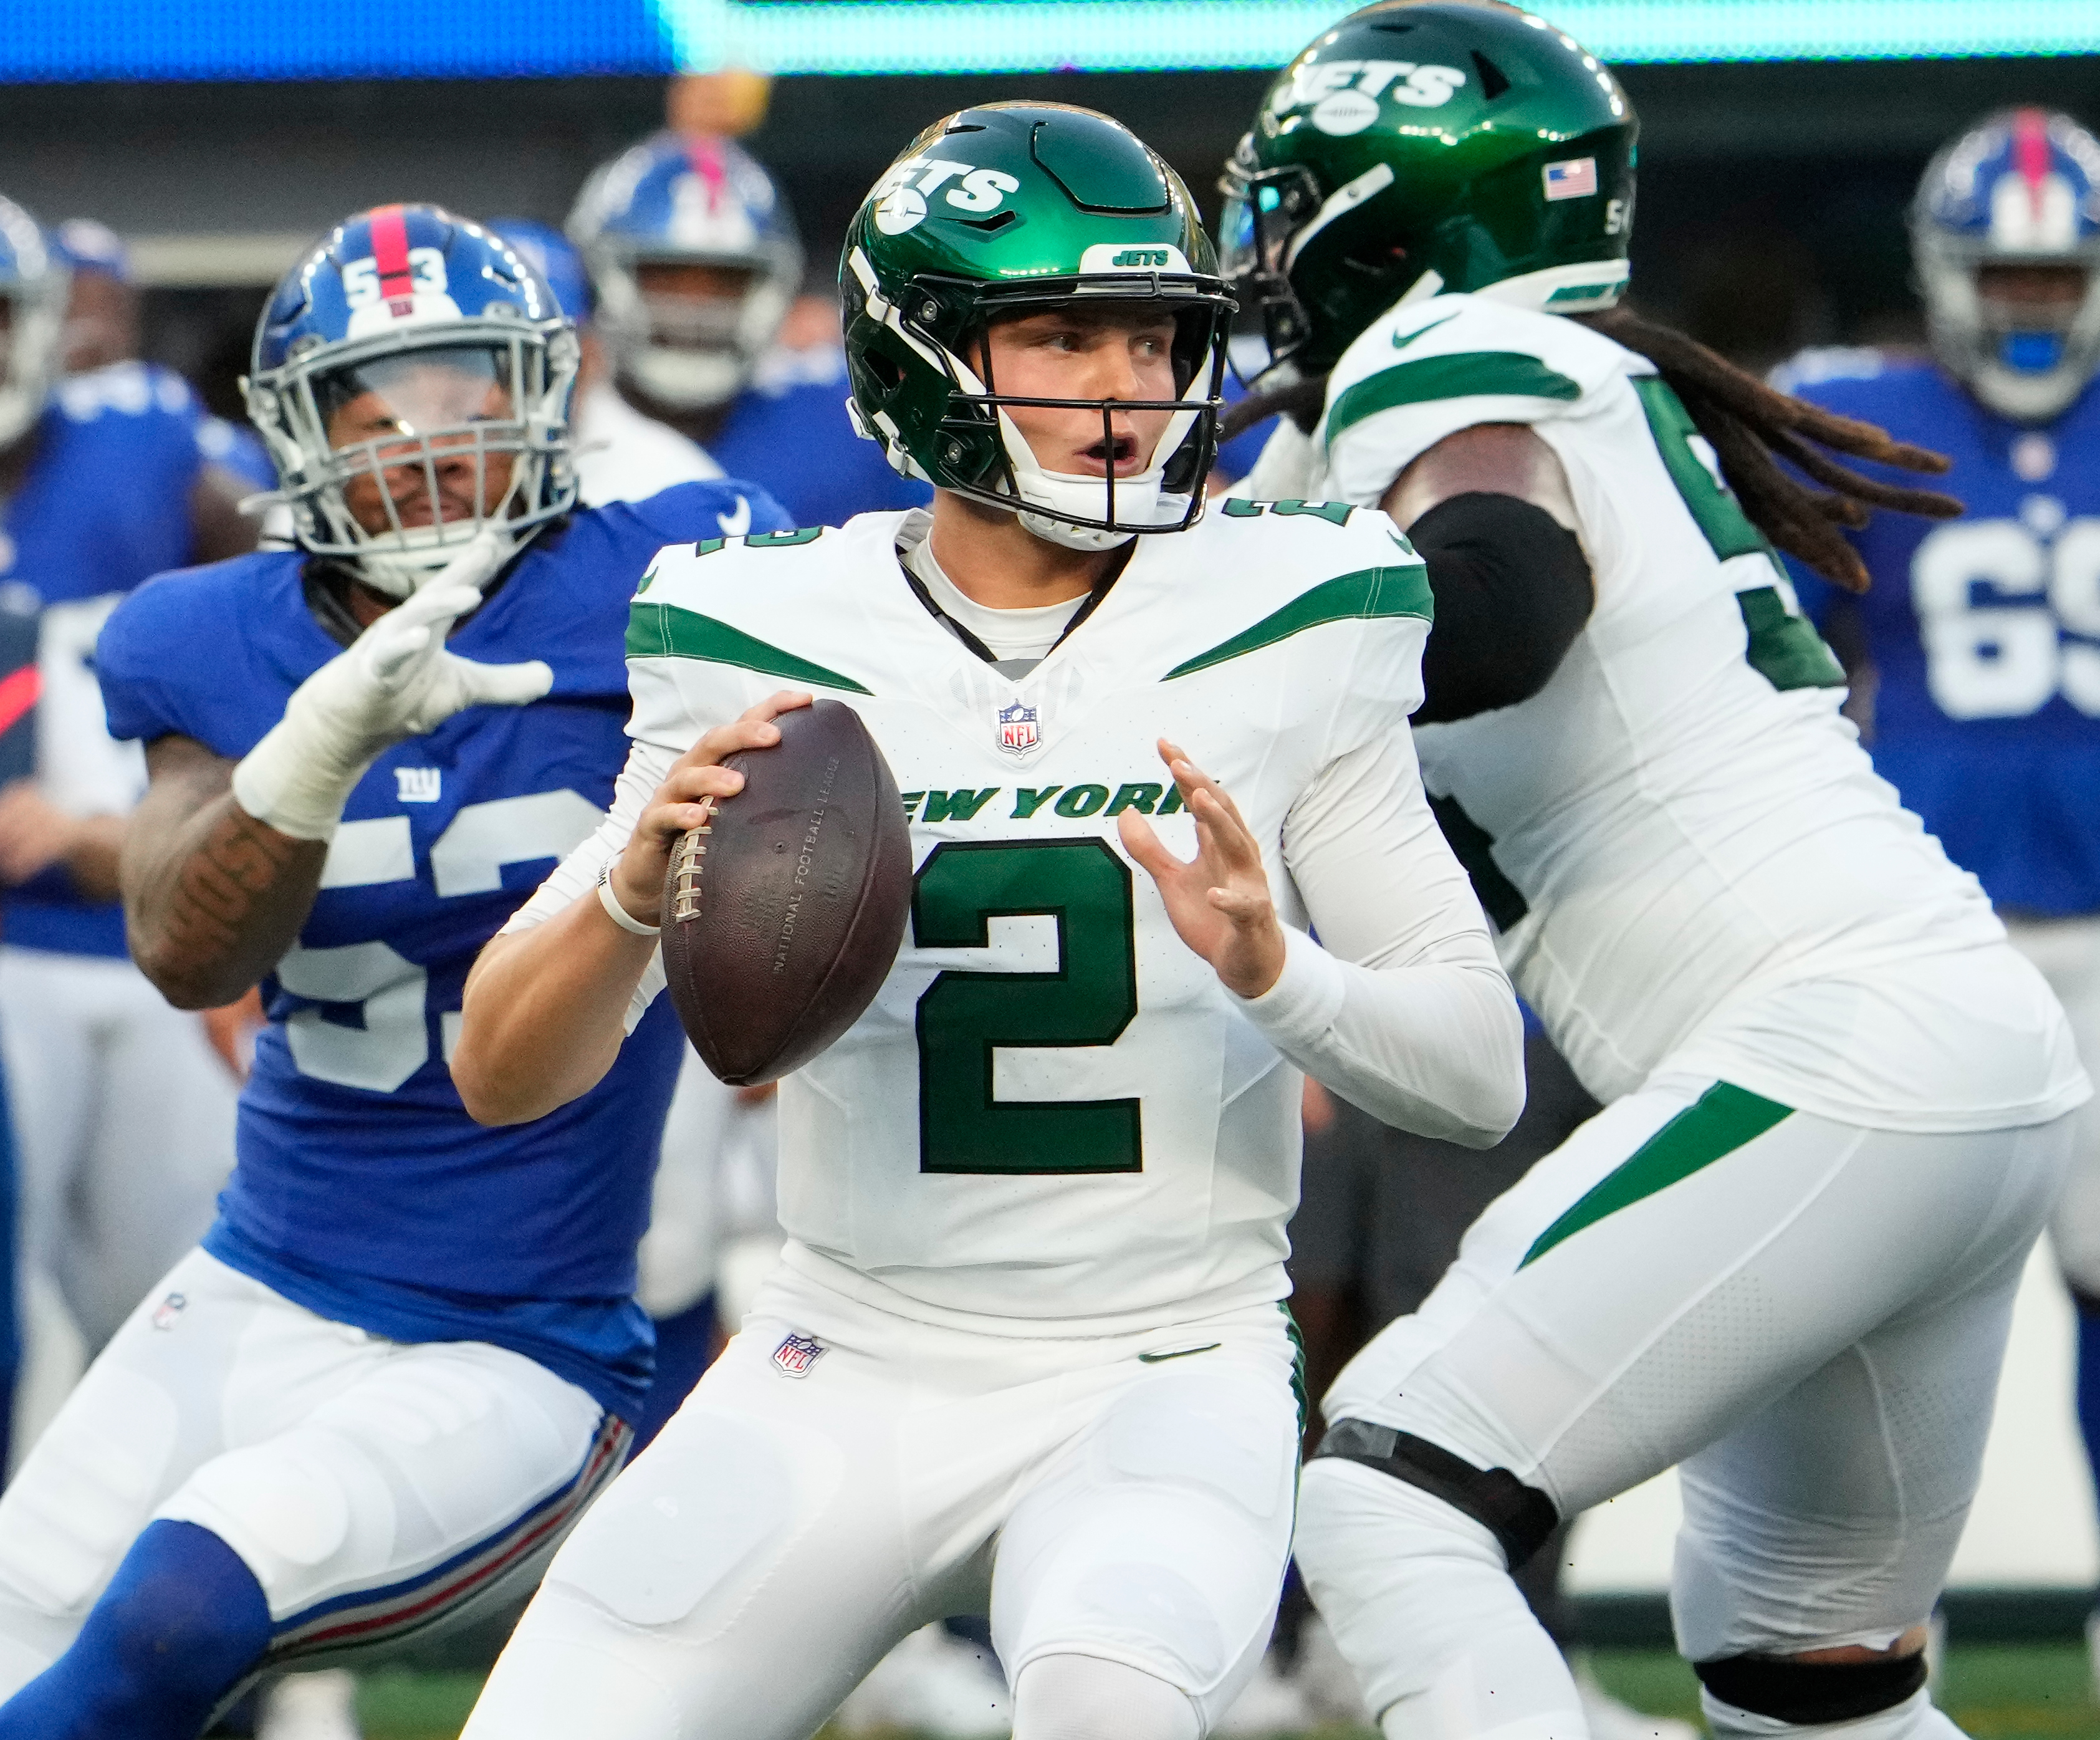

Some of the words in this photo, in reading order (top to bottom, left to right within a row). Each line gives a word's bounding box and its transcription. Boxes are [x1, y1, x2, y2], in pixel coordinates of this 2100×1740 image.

[1112, 250, 1169, 266] JETS
[342, 247, 448, 310] 53
[1002, 724, 1035, 747] NFL
[901, 787, 1001, 822] EW
[774, 894, 802, 974] NATIONAL
[794, 809, 825, 885] FOOTBALL
[911, 838, 1143, 1176] 2
[777, 1345, 808, 1369] NFL
